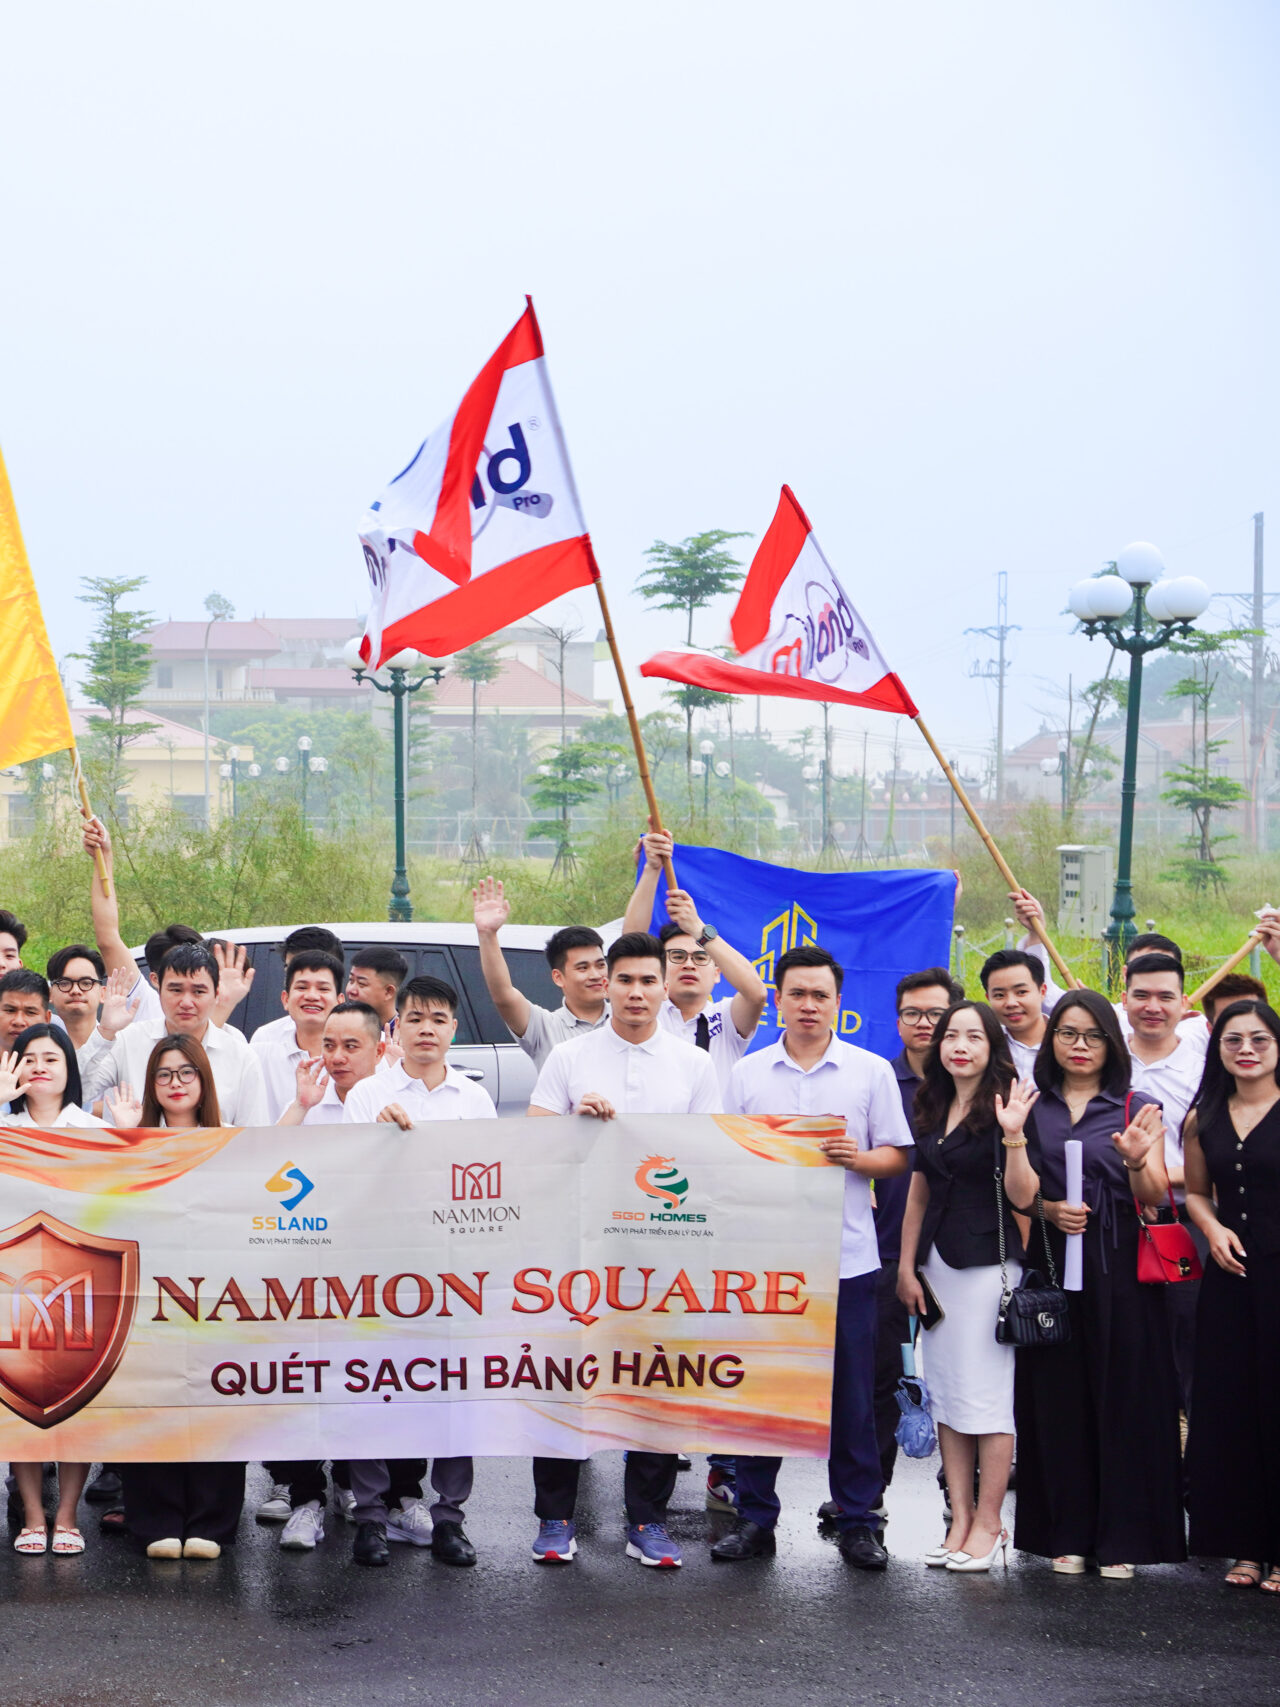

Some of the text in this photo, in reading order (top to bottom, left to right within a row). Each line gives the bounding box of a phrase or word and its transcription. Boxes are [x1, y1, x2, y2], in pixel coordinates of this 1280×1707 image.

[512, 494, 542, 511] Pro
[252, 1216, 328, 1231] SSLAND
[432, 1205, 521, 1225] NAMMON
[612, 1210, 707, 1223] SGO HOMES
[449, 1225, 504, 1234] SQUARE
[151, 1266, 810, 1326] NAMMON SQUARE
[211, 1343, 745, 1403] QUÉT SẠCH BẢNG HÀNG
